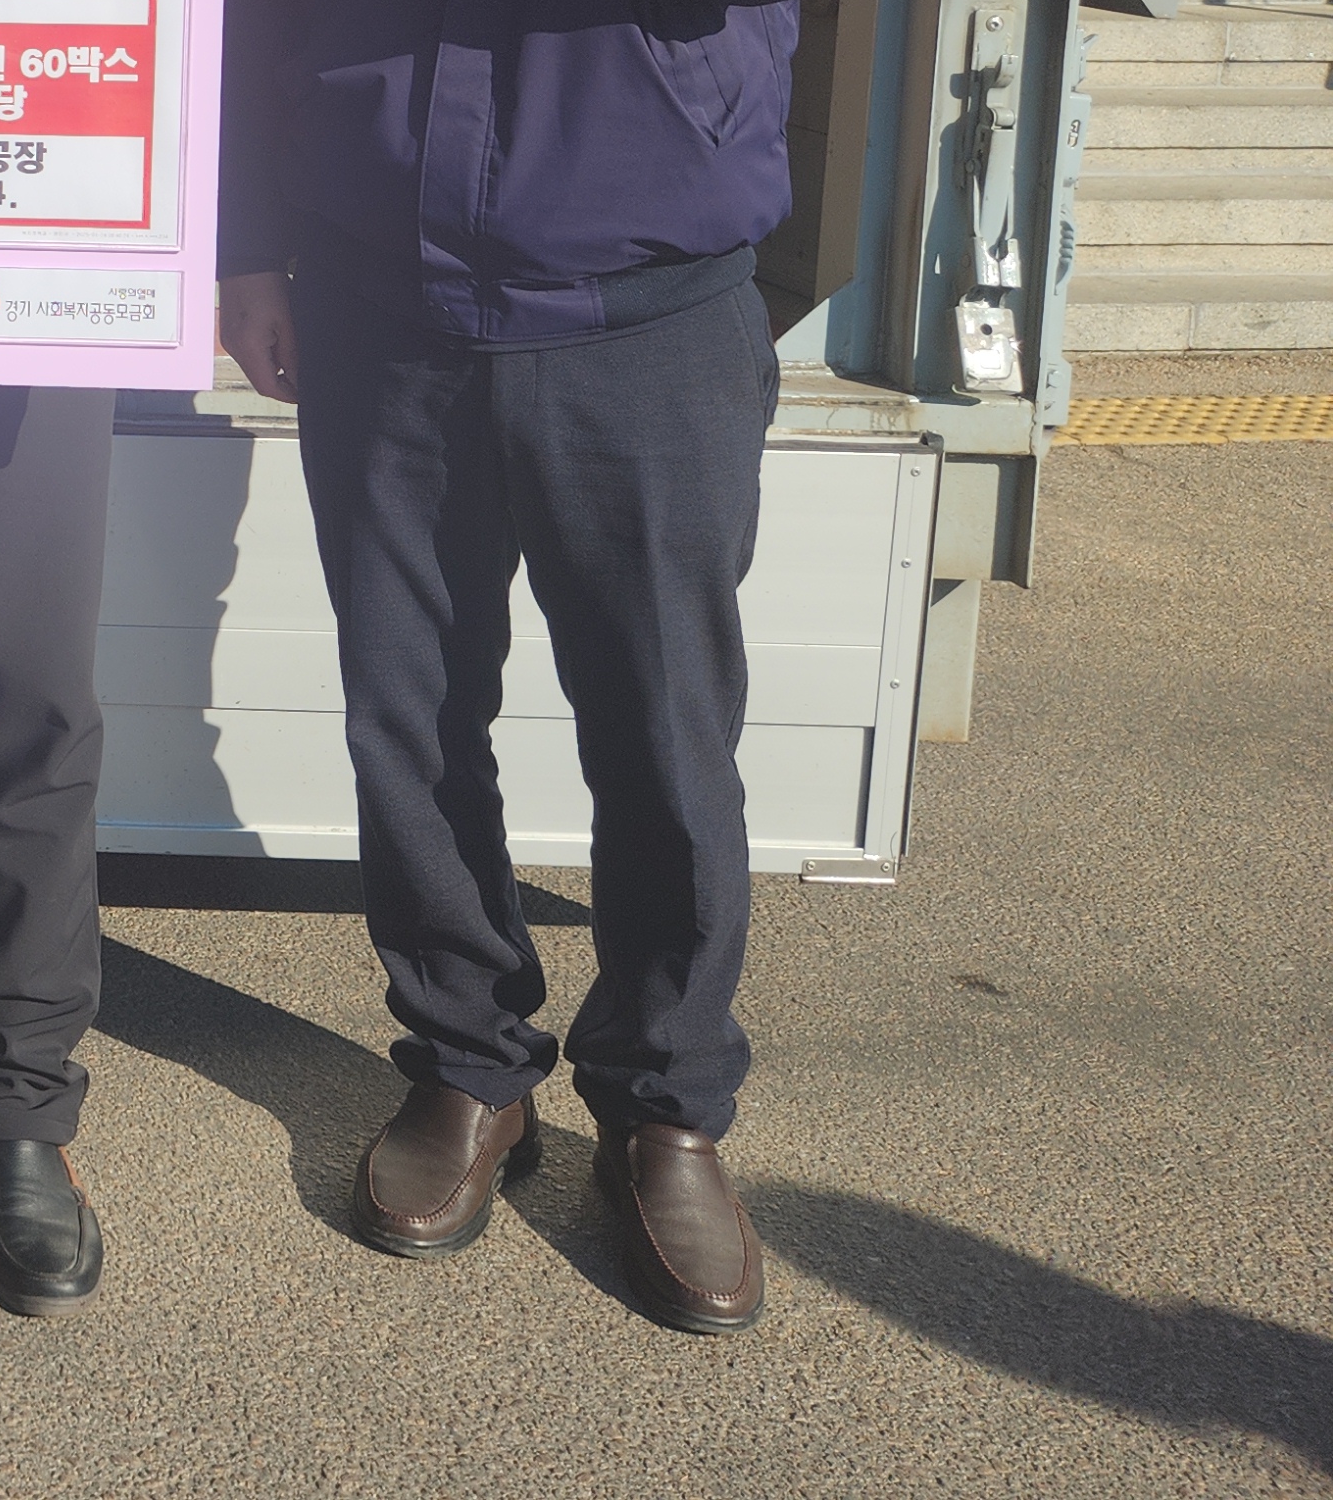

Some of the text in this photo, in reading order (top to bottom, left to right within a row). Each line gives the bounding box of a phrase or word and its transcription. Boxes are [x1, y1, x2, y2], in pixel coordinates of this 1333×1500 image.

[20, 46, 139, 83] 60박스
[5, 300, 156, 325] 경기 사회복지공동모금회
